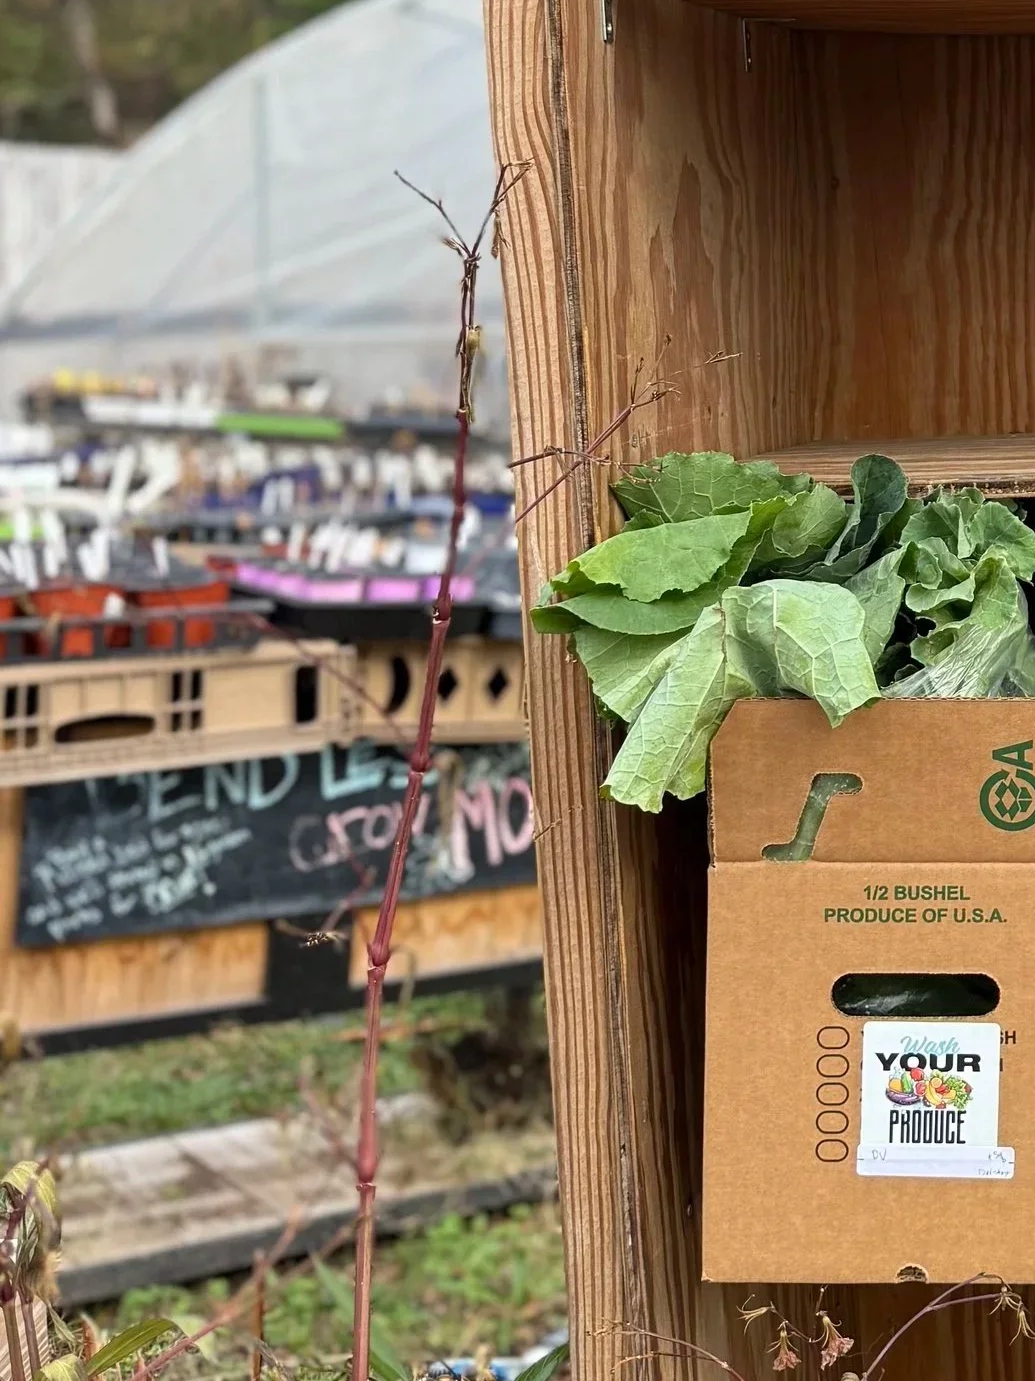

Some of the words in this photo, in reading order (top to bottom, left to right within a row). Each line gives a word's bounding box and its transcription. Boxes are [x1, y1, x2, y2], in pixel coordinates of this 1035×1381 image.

[863, 885, 888, 902] 1/2
[894, 885, 970, 901] BUSHEL
[824, 908, 917, 924] PRODUCE
[922, 908, 948, 923] OF
[953, 908, 1007, 924] U.S.A.
[900, 1035, 961, 1055] Wash
[875, 1052, 981, 1072] YOUR
[889, 1110, 966, 1144] PRODUCE
